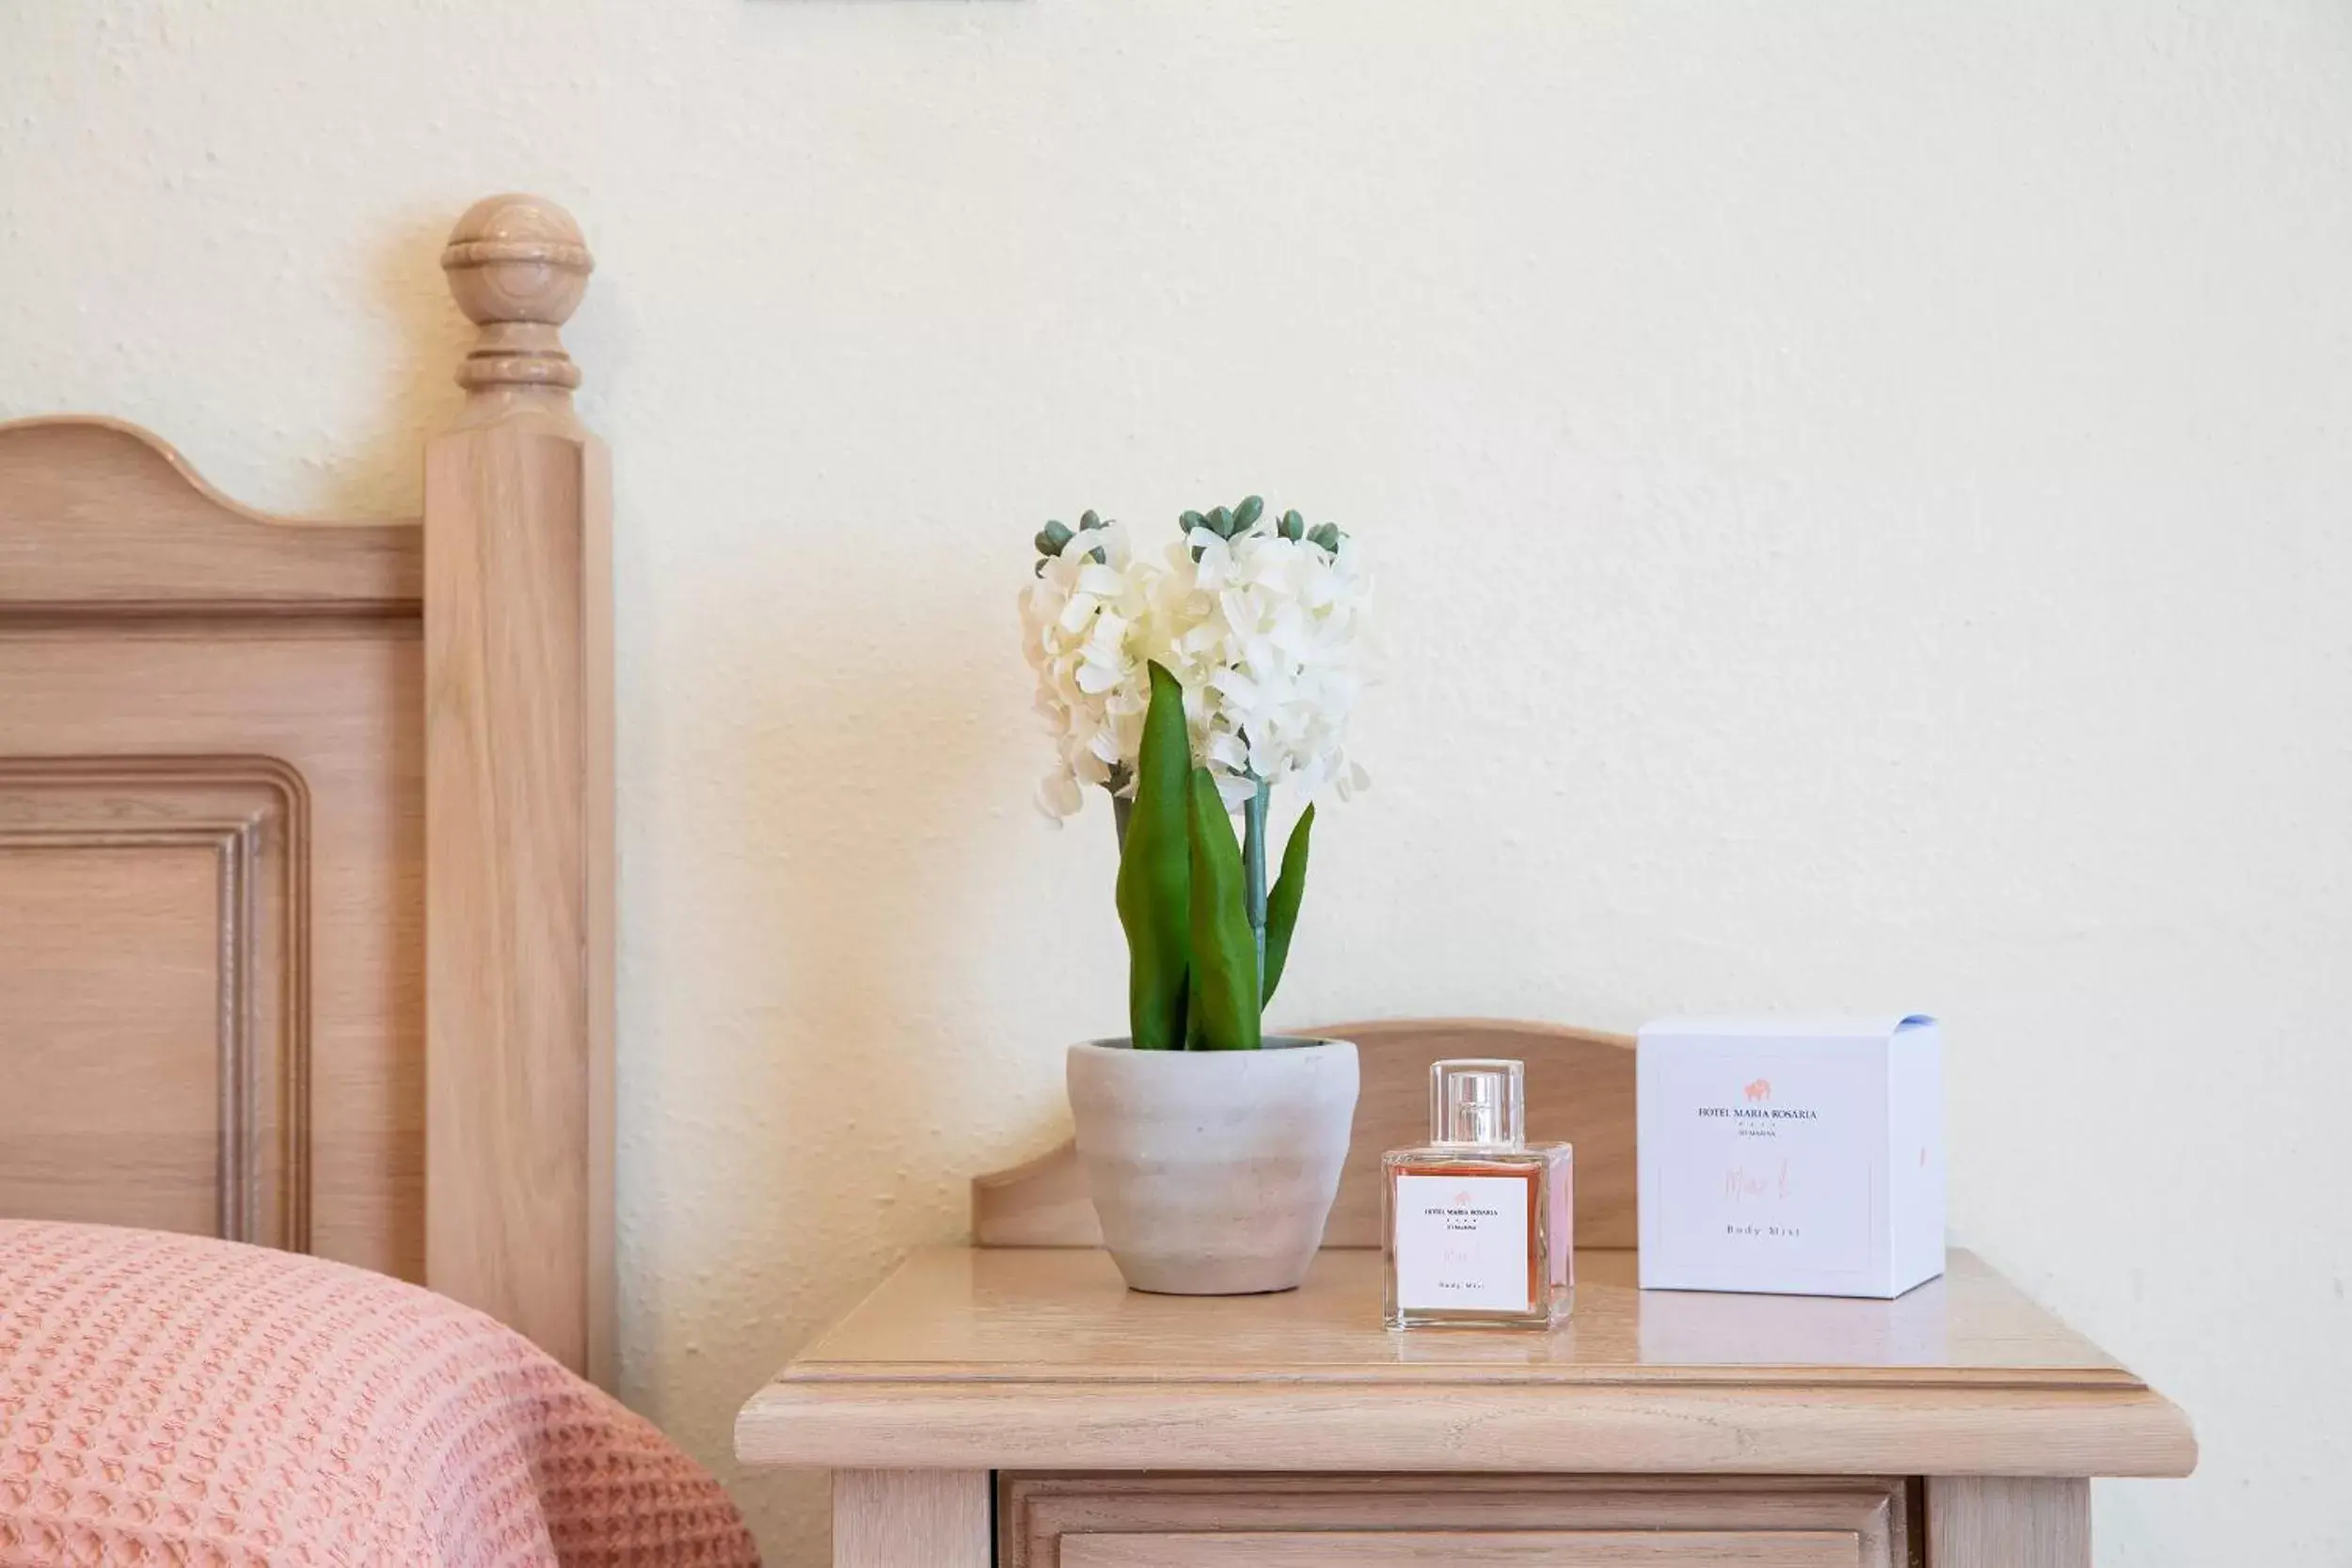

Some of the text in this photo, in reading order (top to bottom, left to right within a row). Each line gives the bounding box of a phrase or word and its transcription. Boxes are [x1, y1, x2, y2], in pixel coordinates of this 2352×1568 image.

[1698, 1107, 1818, 1119] HOTEL MARIA ROSARIA
